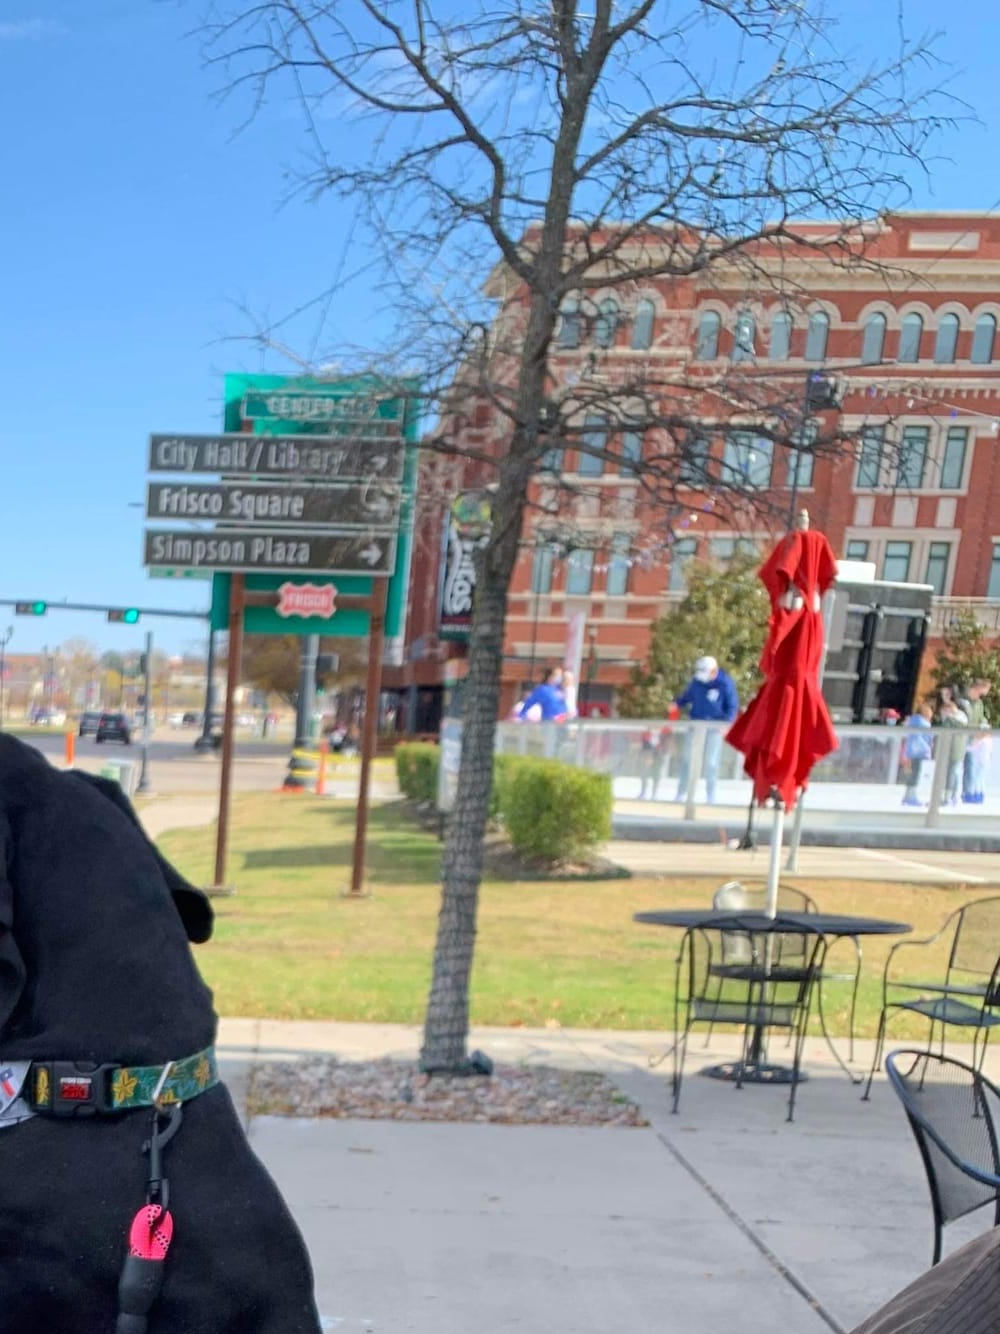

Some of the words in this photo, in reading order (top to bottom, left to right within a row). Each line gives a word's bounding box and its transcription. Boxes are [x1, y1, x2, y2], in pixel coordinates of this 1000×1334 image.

[157, 440, 198, 471] City
[203, 441, 247, 468] Hall
[267, 444, 345, 474] Library
[158, 487, 224, 514] Frisco
[228, 489, 305, 520] Square
[152, 534, 246, 565] Simpson
[251, 537, 310, 563] Plaza
